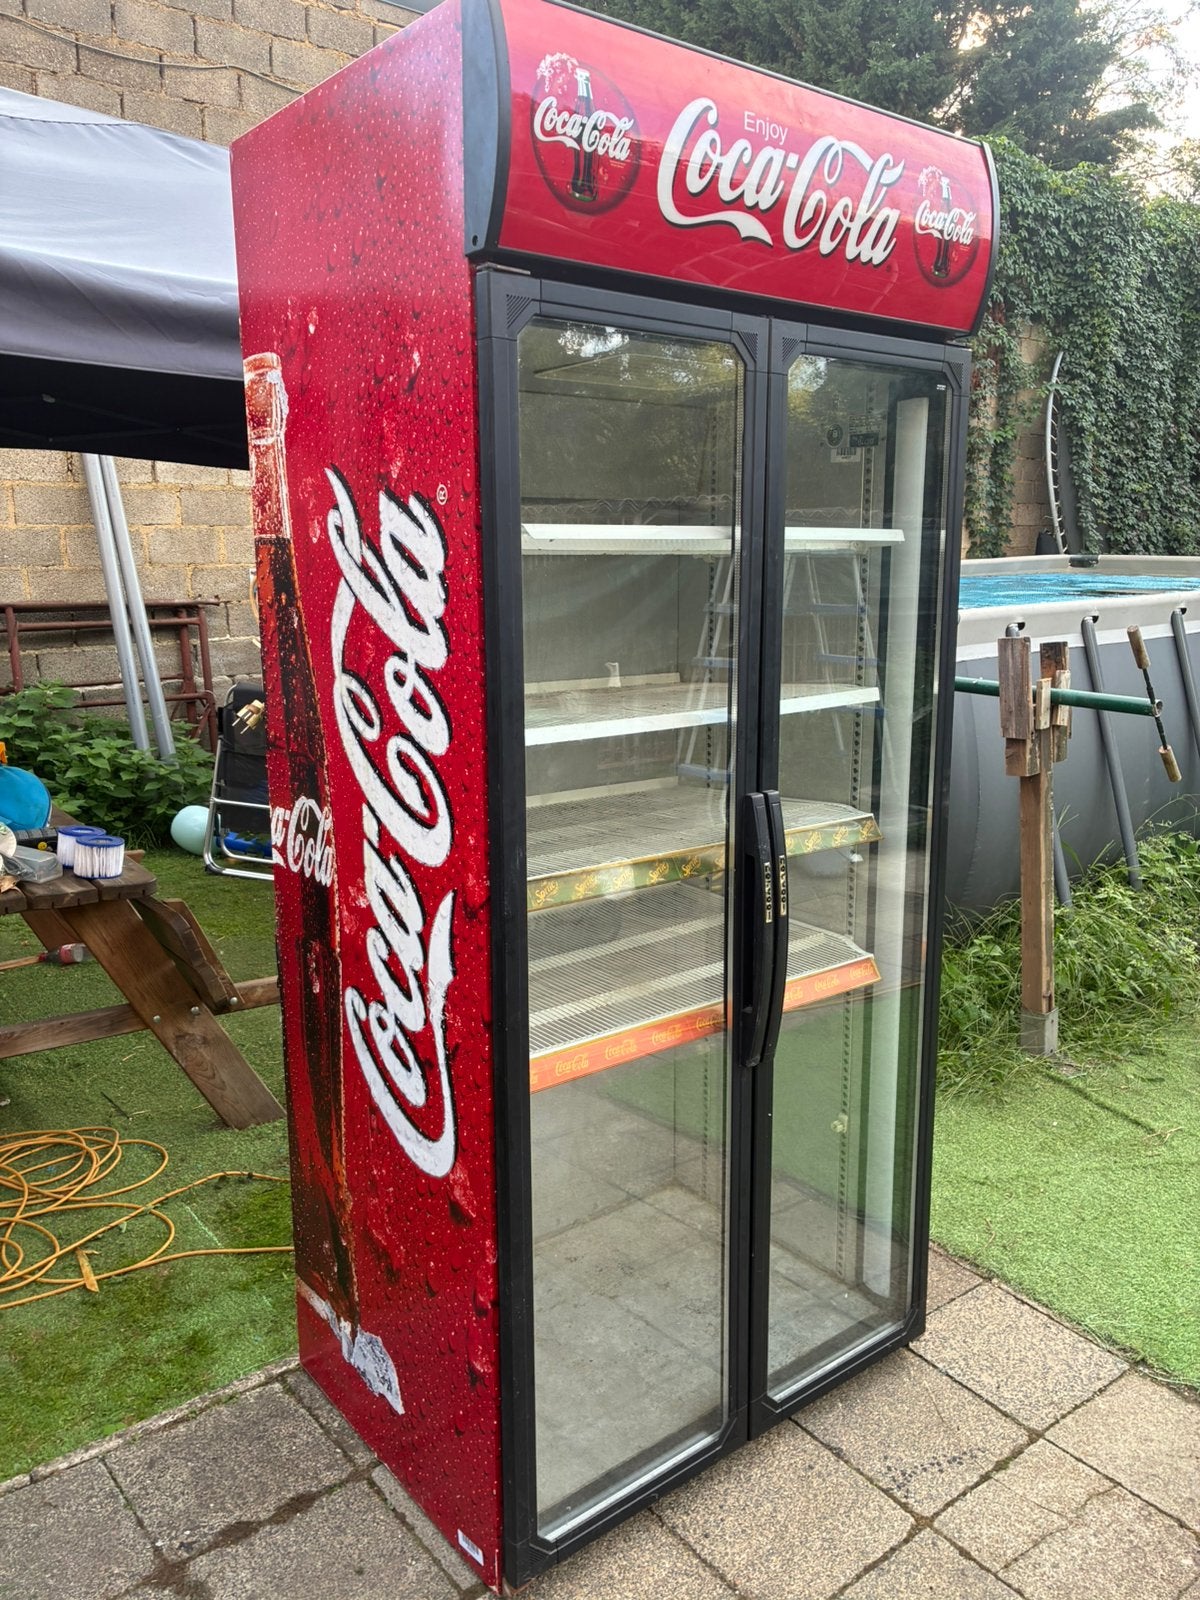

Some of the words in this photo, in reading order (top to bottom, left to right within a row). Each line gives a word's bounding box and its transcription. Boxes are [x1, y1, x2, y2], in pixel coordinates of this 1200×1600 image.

[533, 96, 634, 161] Coca-Cola
[743, 110, 789, 146] Enjoy
[656, 97, 905, 267] Coca-Cola
[914, 199, 977, 246] Coca-Cola
[270, 795, 334, 888] a-Cola
[324, 464, 458, 1178] Coca-Cola
